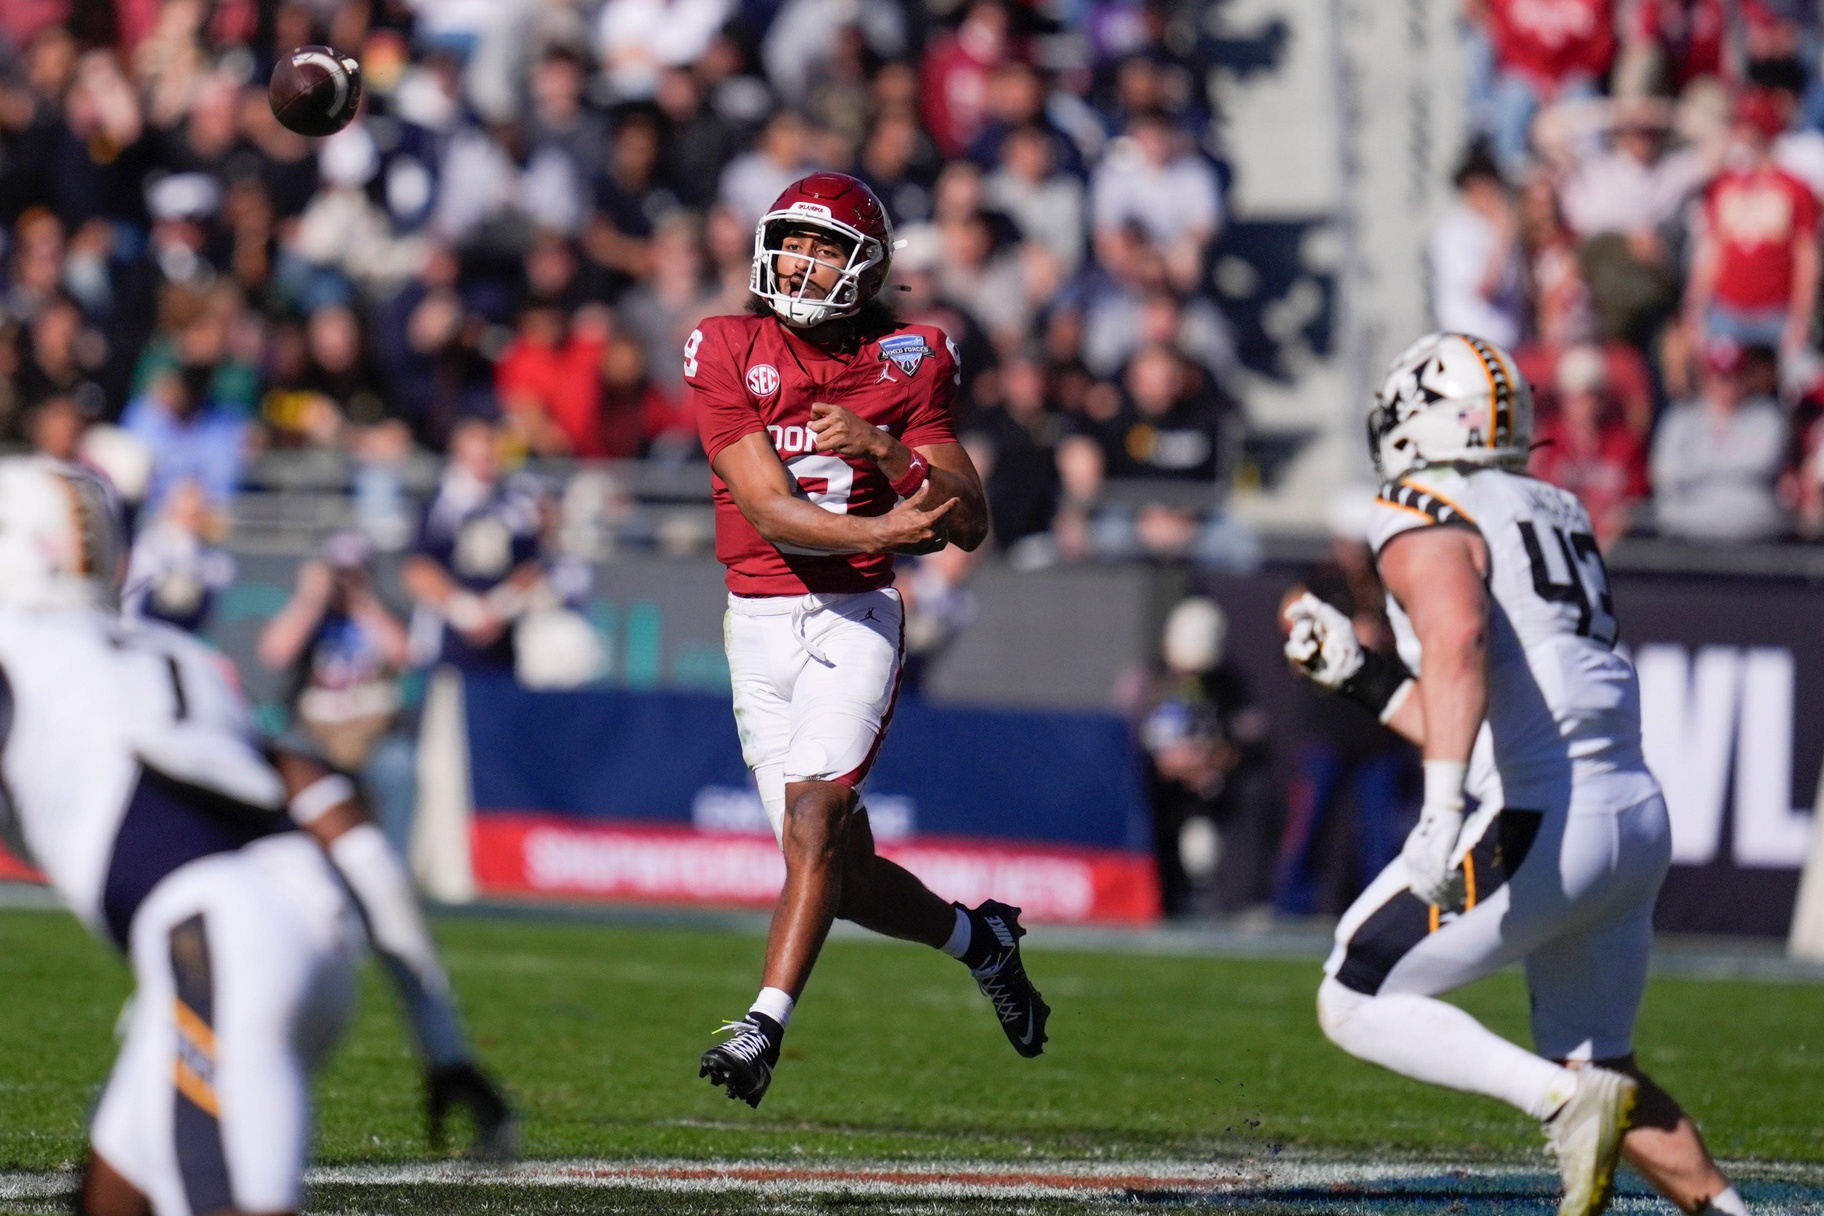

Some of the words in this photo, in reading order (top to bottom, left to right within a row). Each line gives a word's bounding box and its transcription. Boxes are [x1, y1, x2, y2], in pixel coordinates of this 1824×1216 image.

[798, 204, 824, 213] OKLAHOMA
[882, 348, 903, 358] ARMED
[903, 346, 929, 354] FORCES
[749, 366, 777, 395] SEC
[983, 915, 1016, 947] NIKE
